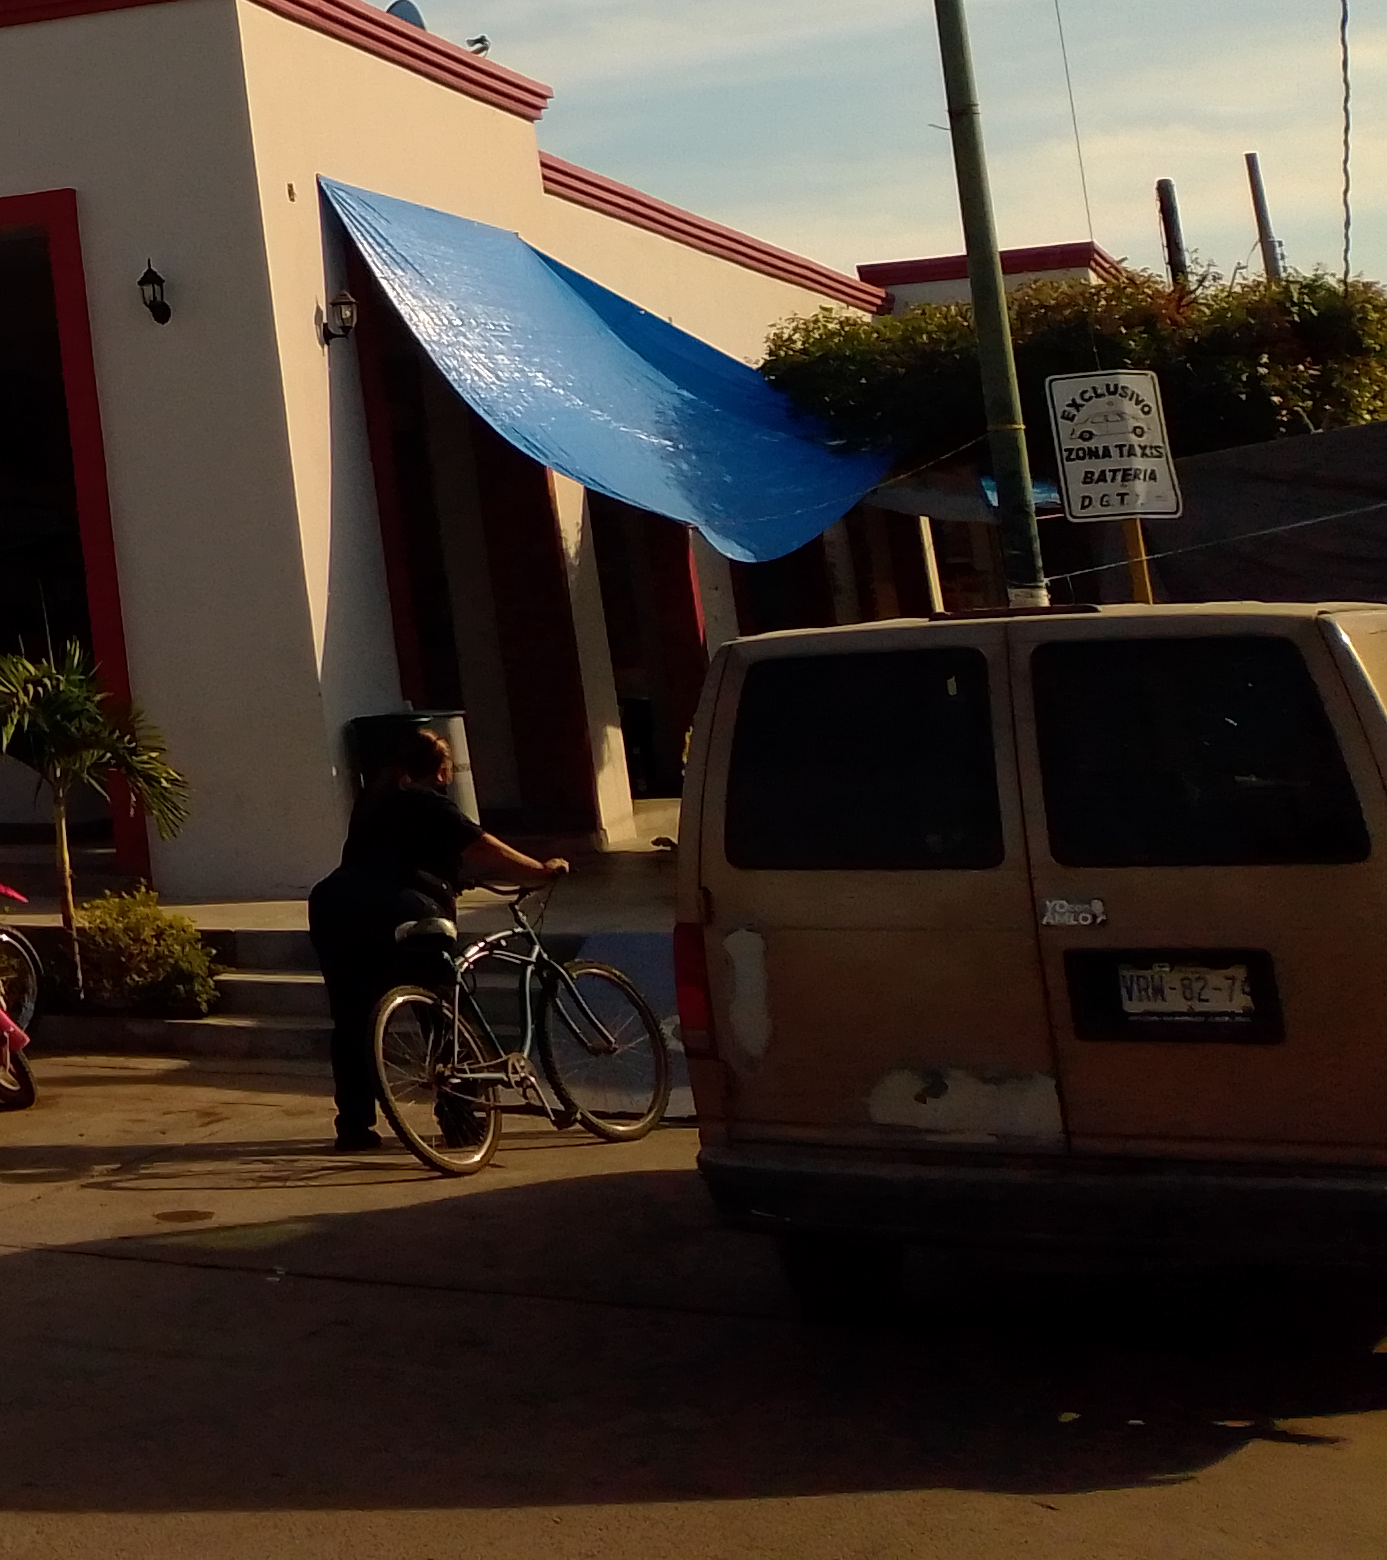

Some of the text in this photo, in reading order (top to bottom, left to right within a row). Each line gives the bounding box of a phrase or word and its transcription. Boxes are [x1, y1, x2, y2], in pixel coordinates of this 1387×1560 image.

[1060, 383, 1153, 423] EXCLUSIVO
[1063, 443, 1164, 463] ZONA TAXIS
[1081, 467, 1158, 485] BATERIA
